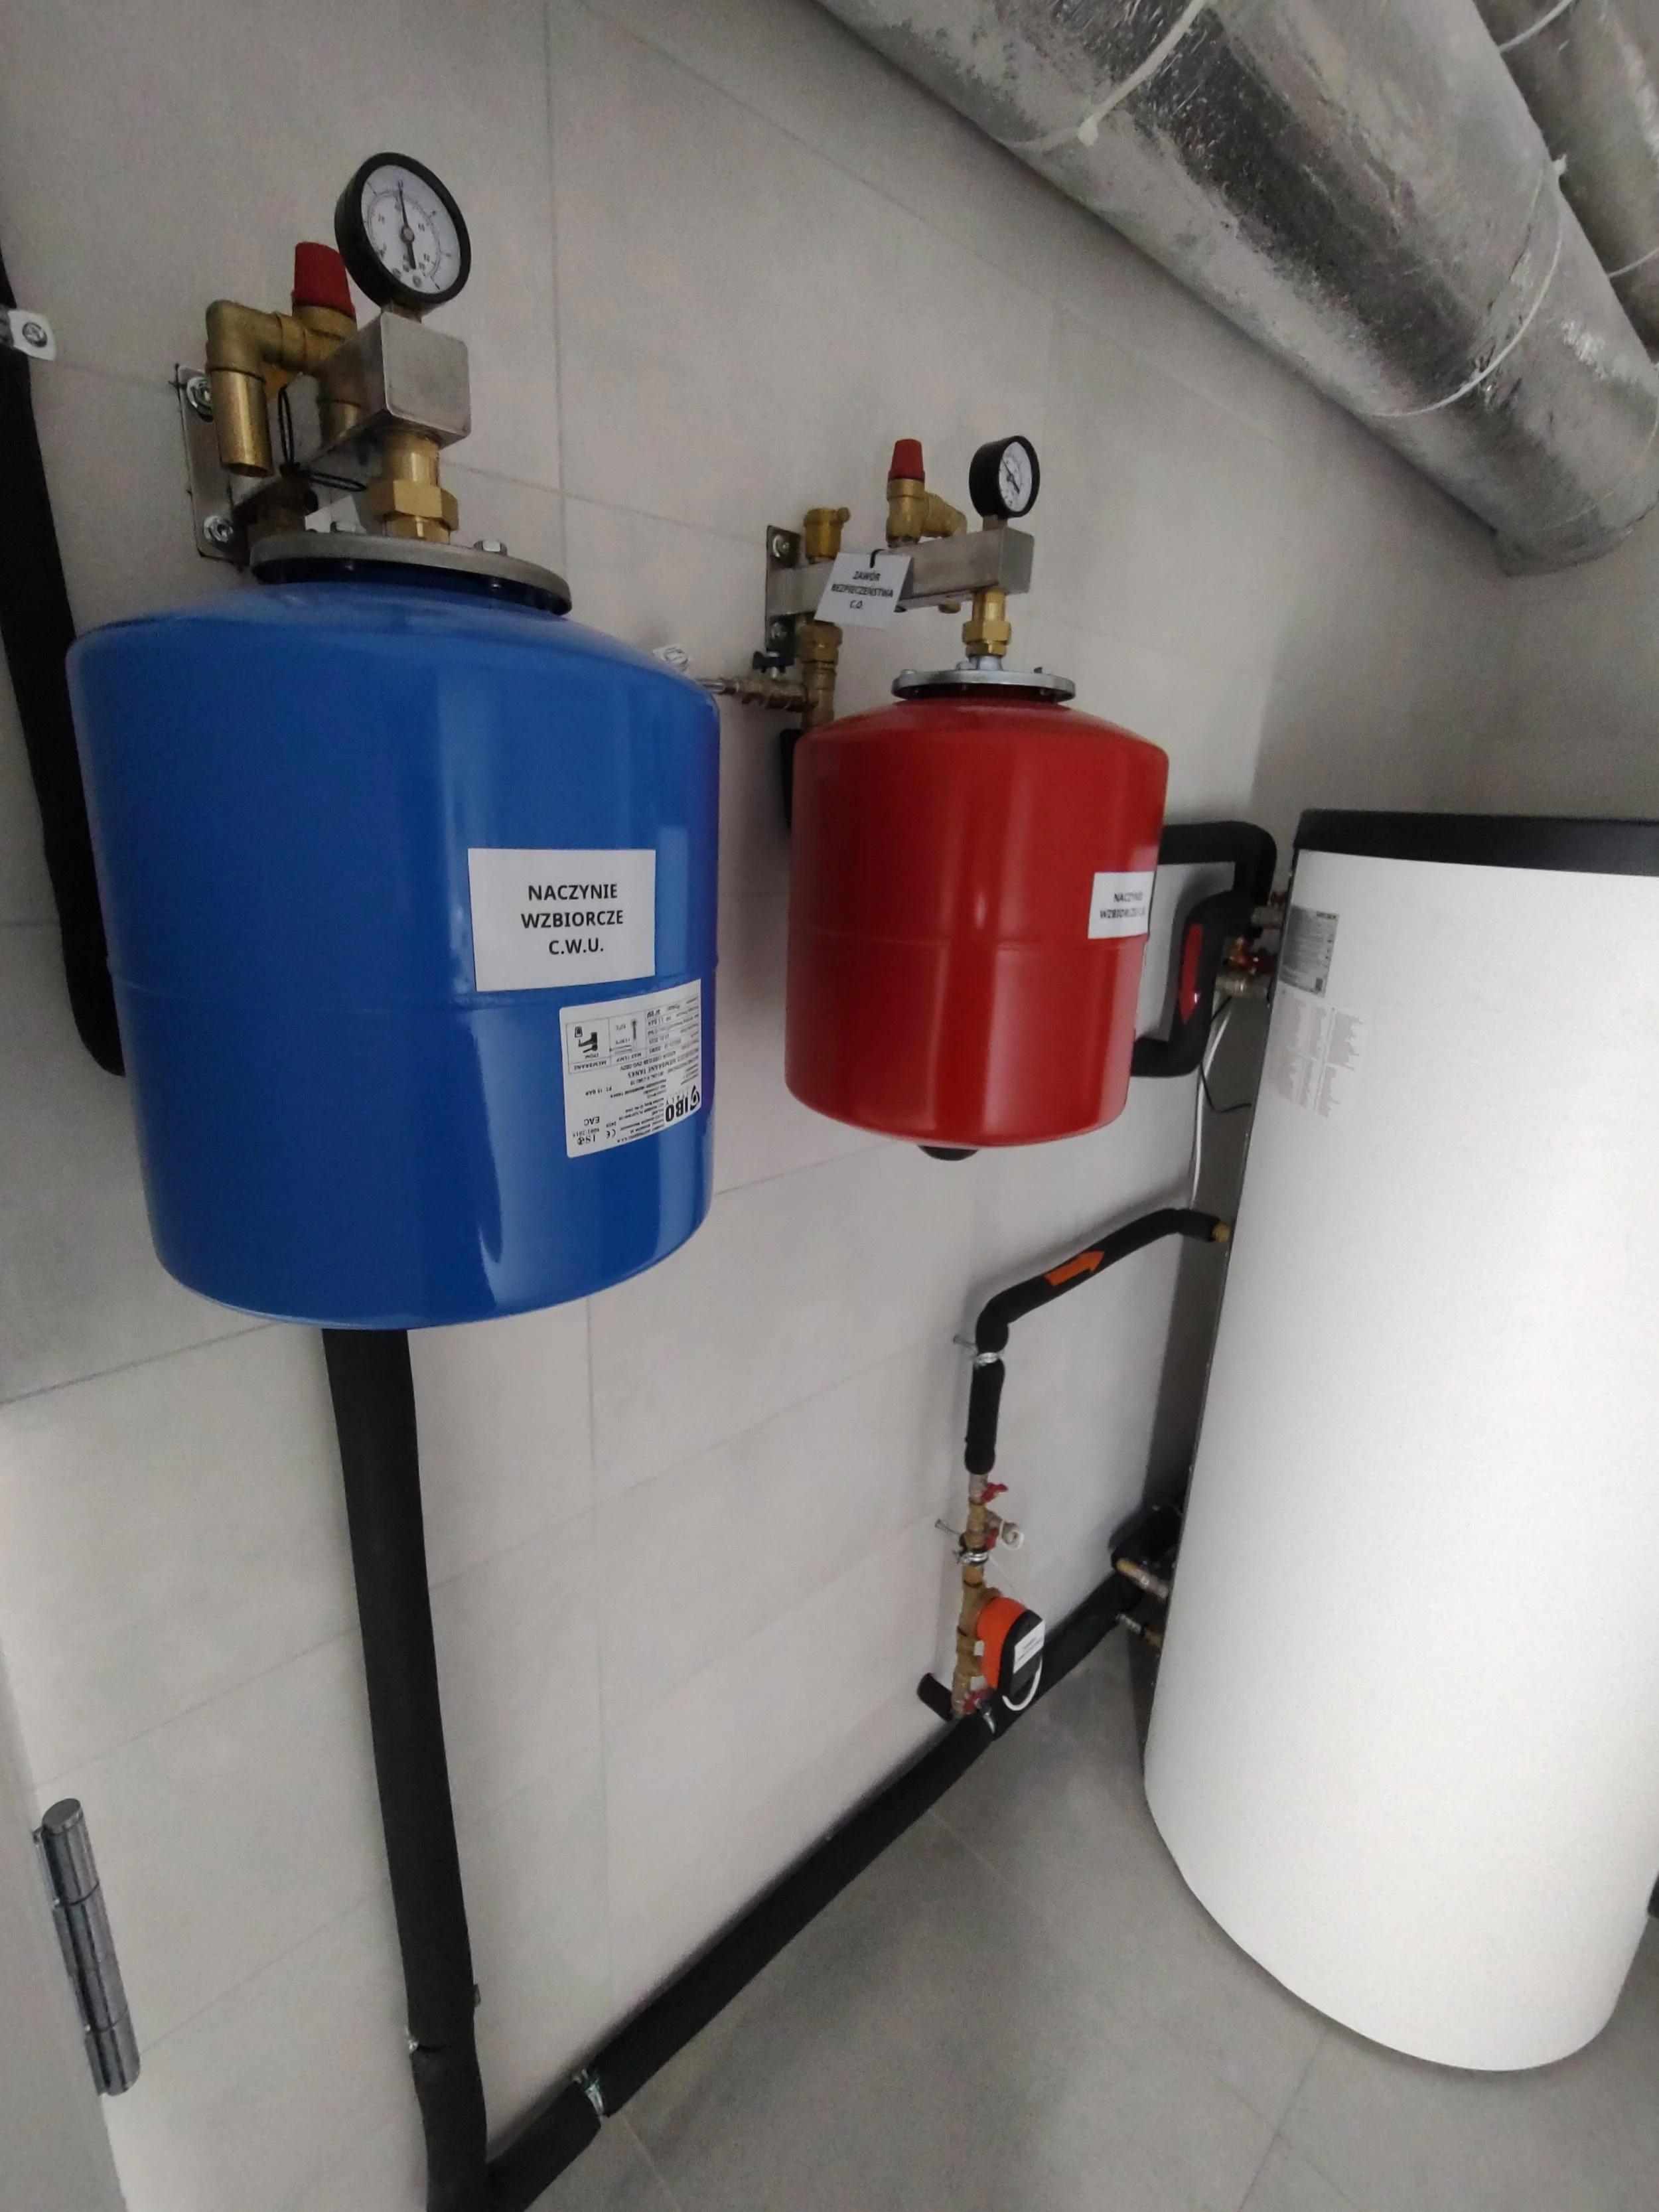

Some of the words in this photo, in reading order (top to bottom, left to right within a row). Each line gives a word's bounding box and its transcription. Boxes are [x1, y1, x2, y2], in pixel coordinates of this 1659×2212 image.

[528, 883, 618, 901] NACZYNIE
[521, 910, 624, 928] WZBIORCZE
[548, 937, 605, 955] C.W.U.
[573, 1060, 607, 1070] MEMBRANE
[628, 1069, 646, 1078] TANKS
[665, 1096, 689, 1122] IBO
[583, 1116, 600, 1126] EAC
